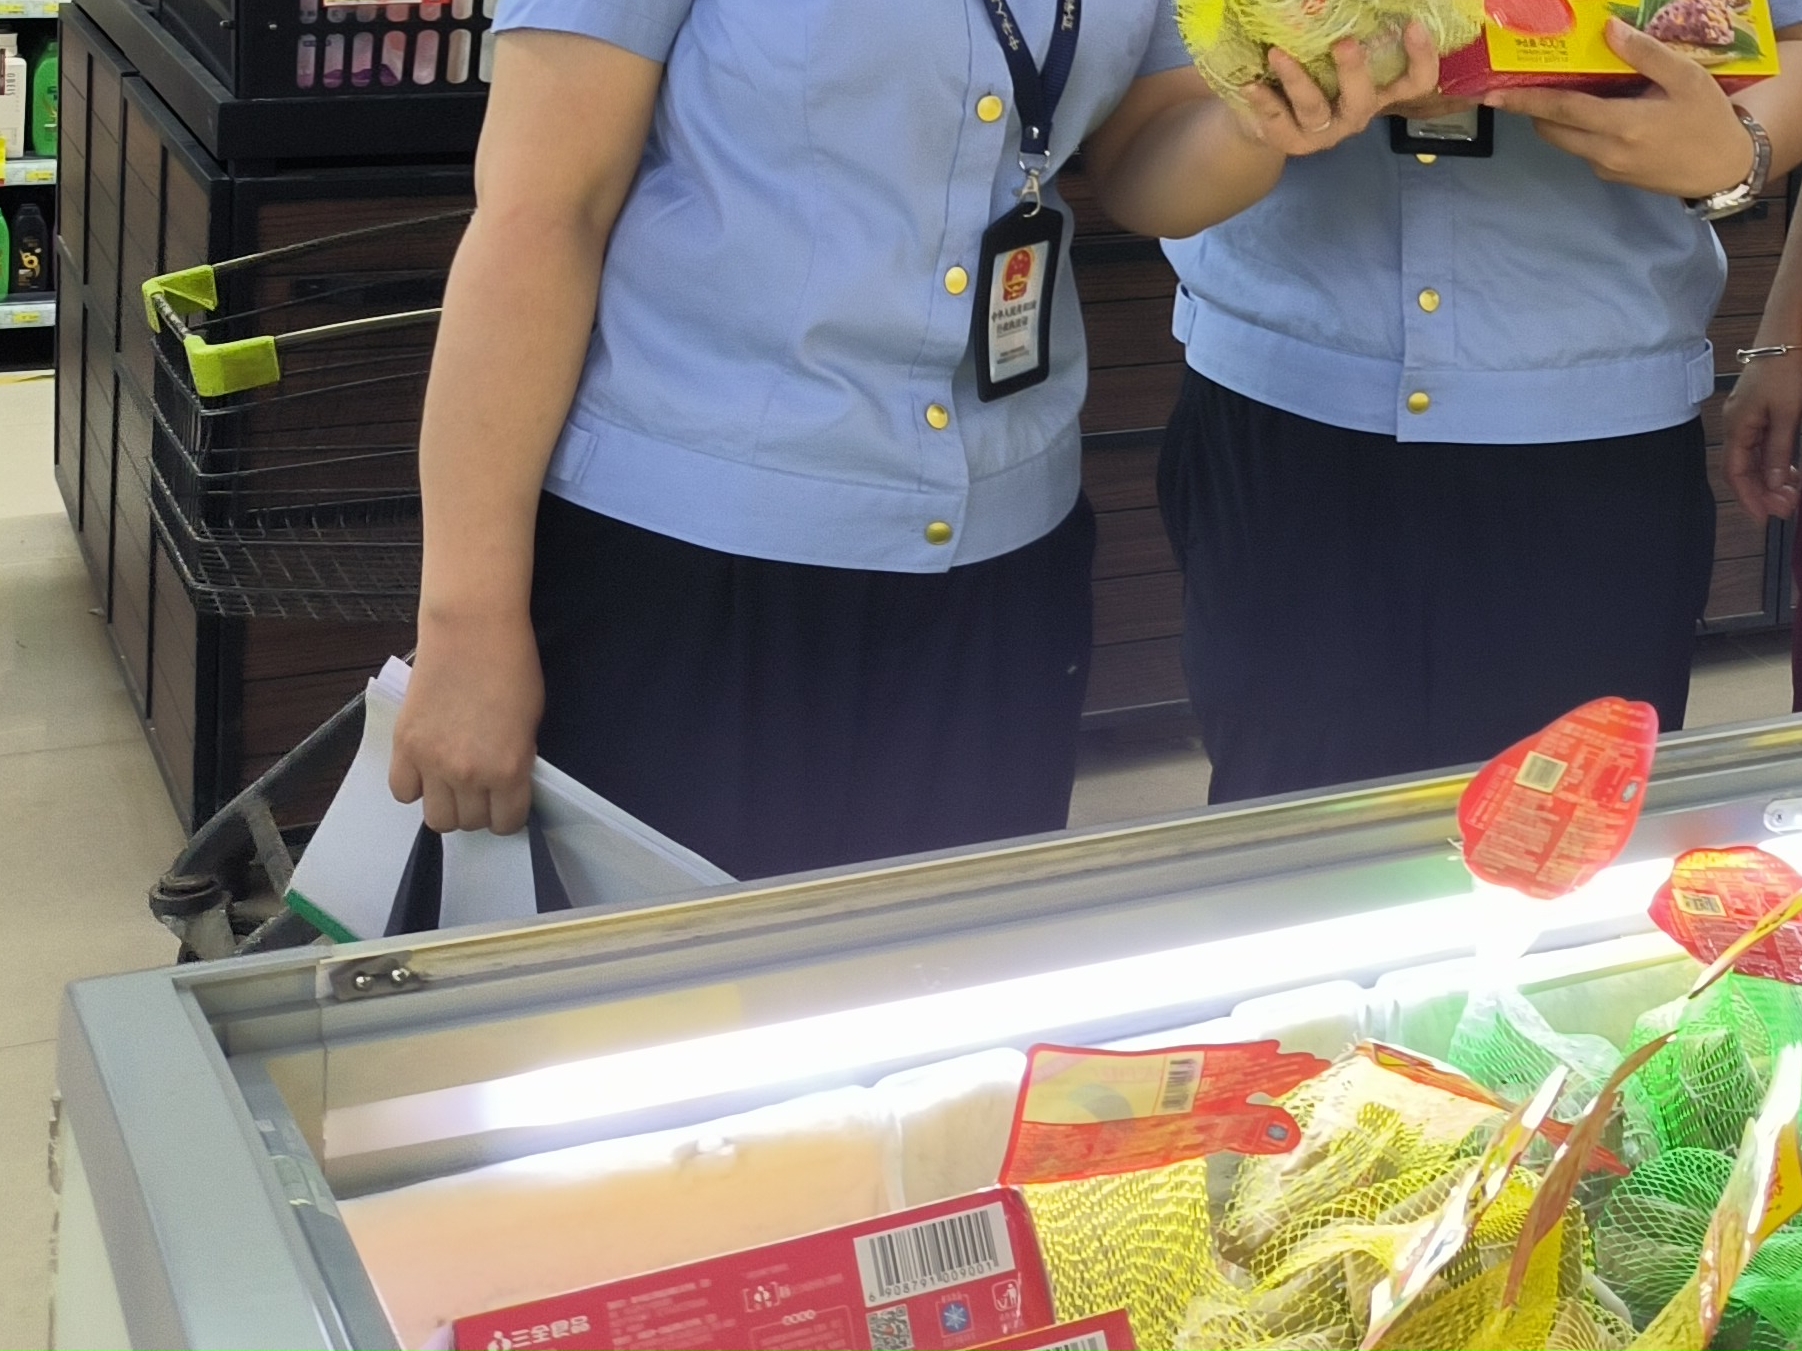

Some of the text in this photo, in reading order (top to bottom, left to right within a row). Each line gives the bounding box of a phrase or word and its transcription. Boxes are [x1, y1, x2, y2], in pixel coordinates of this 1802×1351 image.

[884, 1275, 937, 1298] 908791
[942, 1261, 993, 1284] 009001
[510, 1315, 592, 1348] 三全食品
